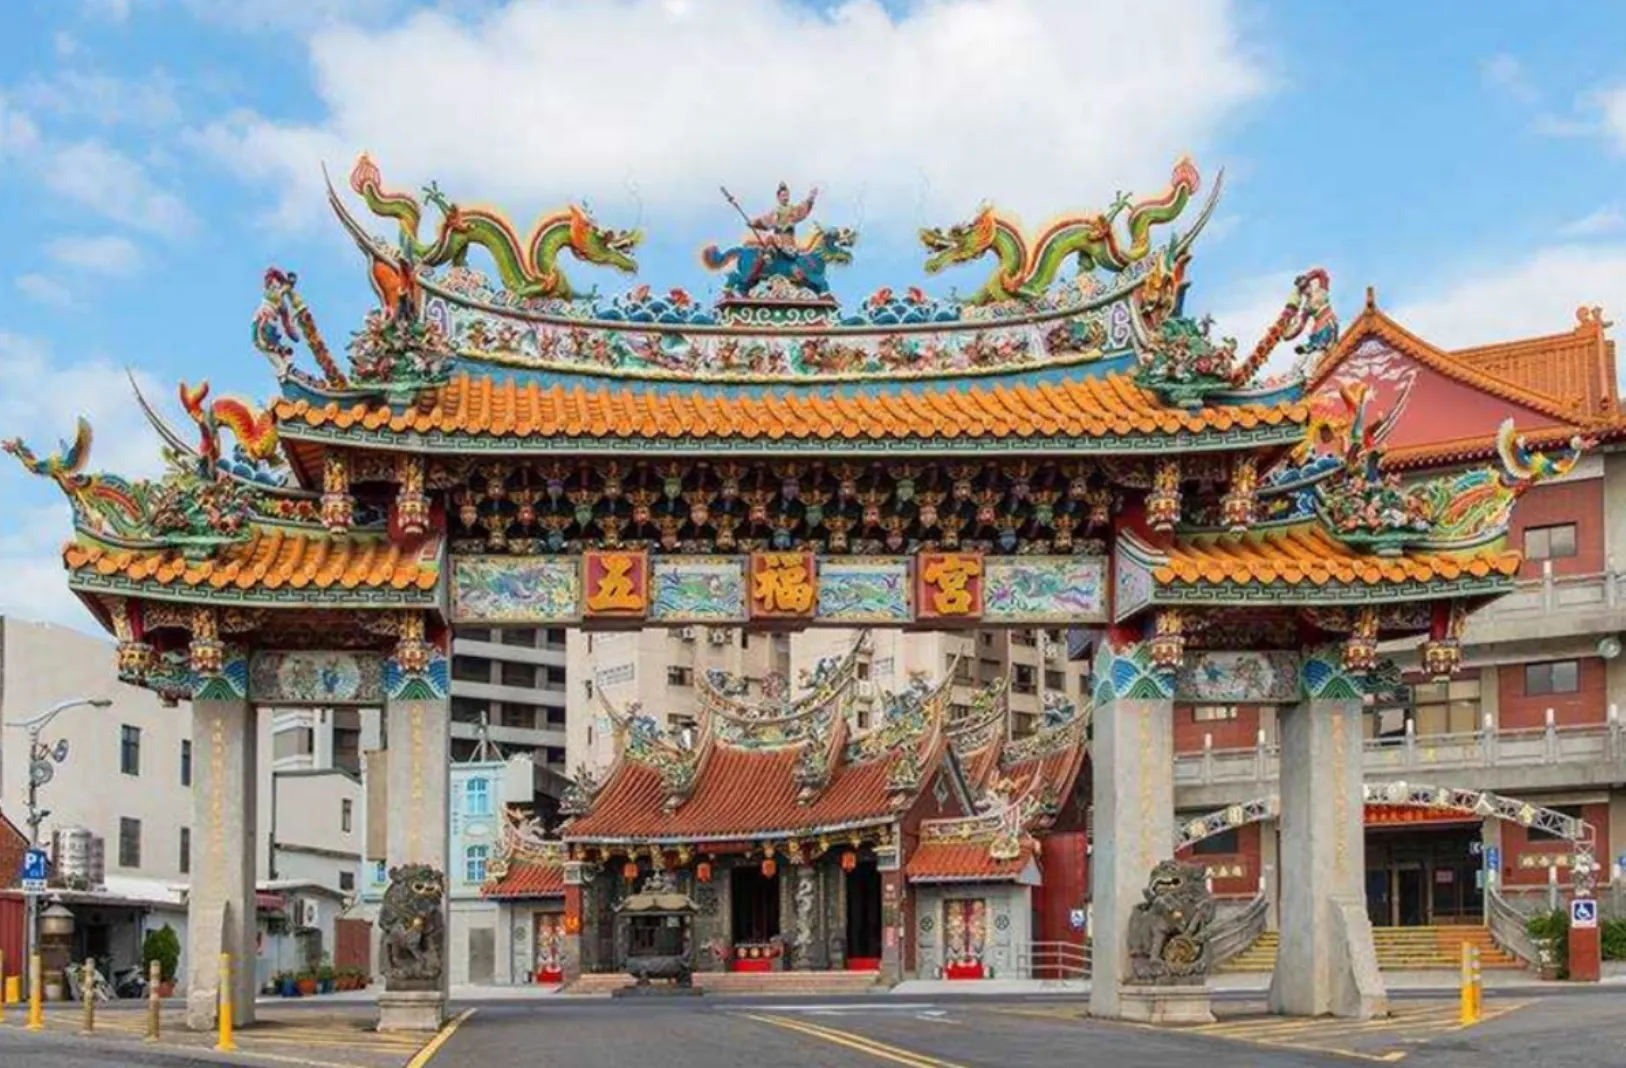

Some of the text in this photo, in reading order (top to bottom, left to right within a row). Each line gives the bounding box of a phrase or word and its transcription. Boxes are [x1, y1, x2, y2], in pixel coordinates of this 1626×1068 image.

[588, 555, 979, 614] 五福宮
[25, 852, 37, 870] P
